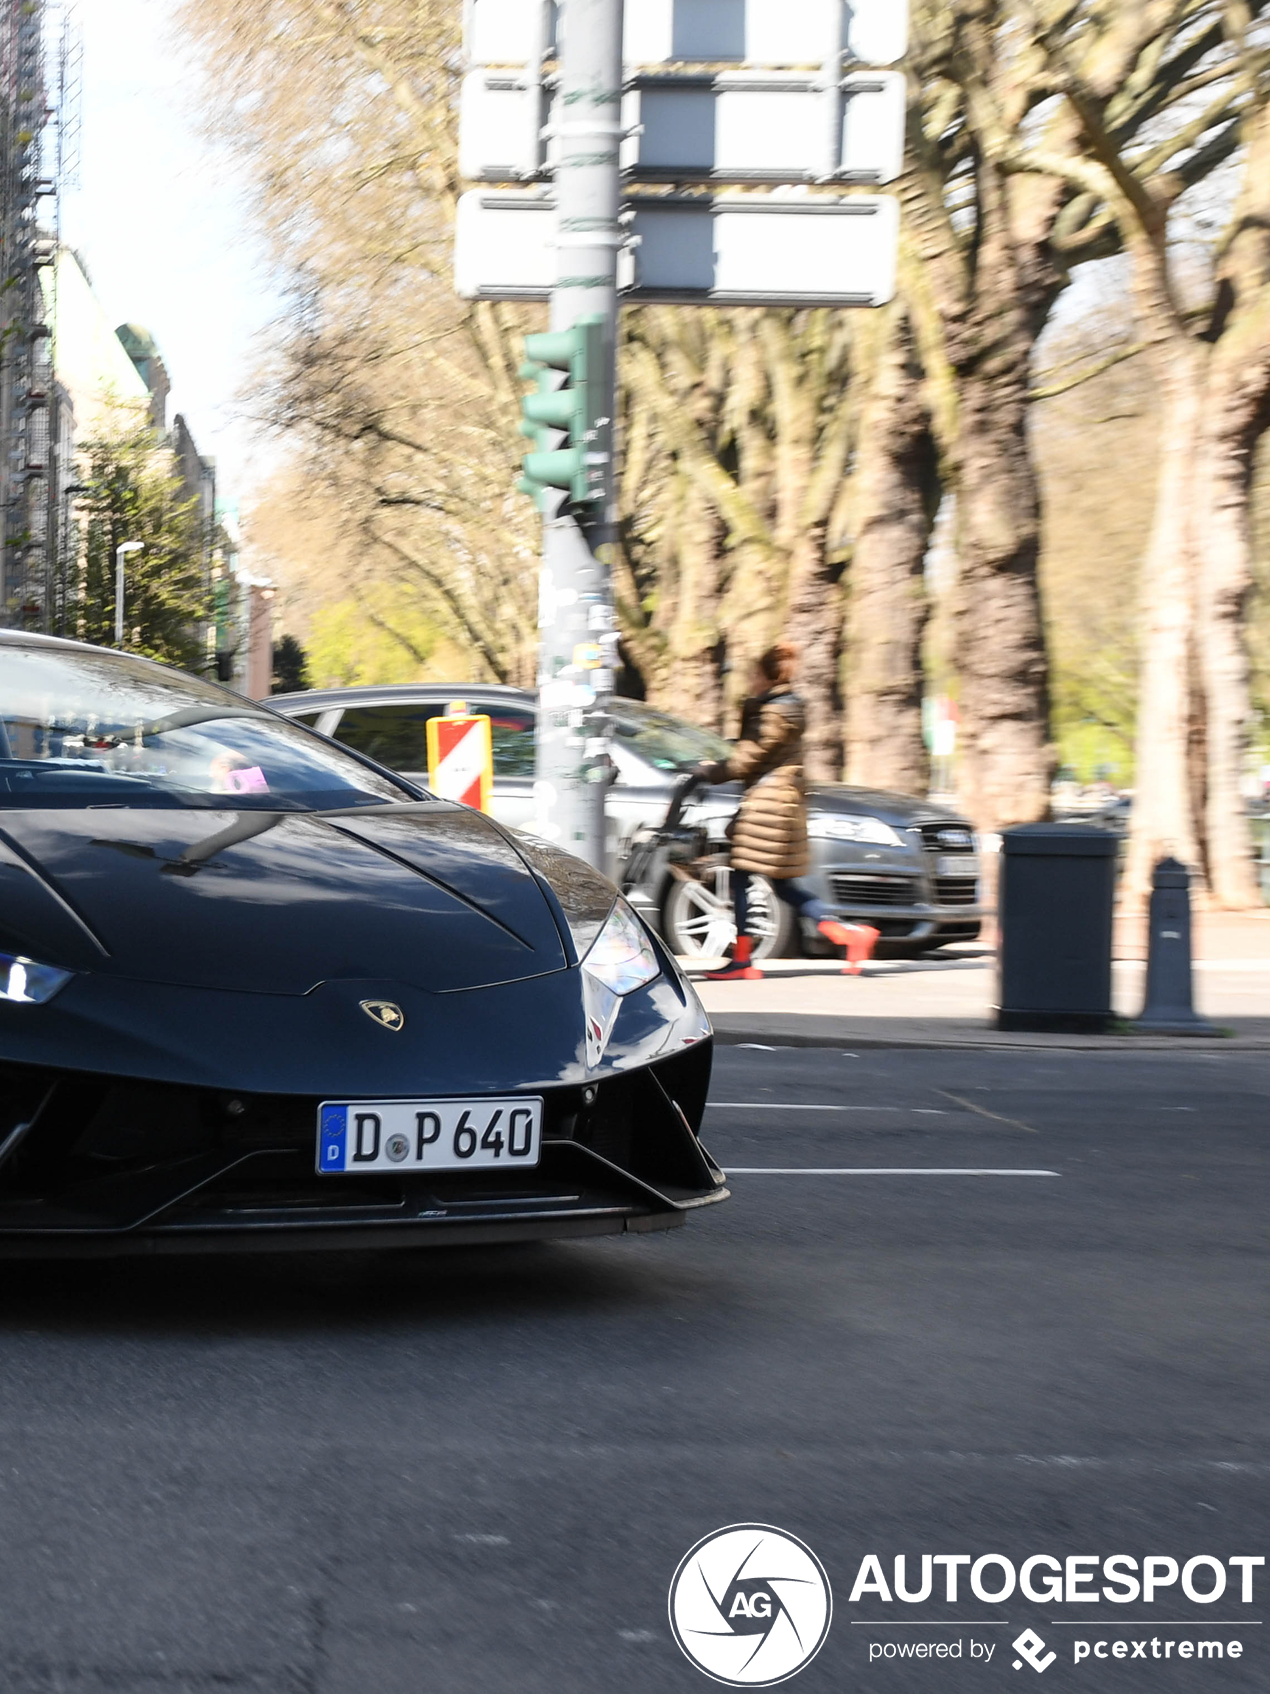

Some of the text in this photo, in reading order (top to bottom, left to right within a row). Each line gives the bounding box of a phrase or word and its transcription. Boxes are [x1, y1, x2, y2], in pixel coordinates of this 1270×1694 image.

[327, 1144, 339, 1162] D
[352, 1107, 533, 1163] D P 640
